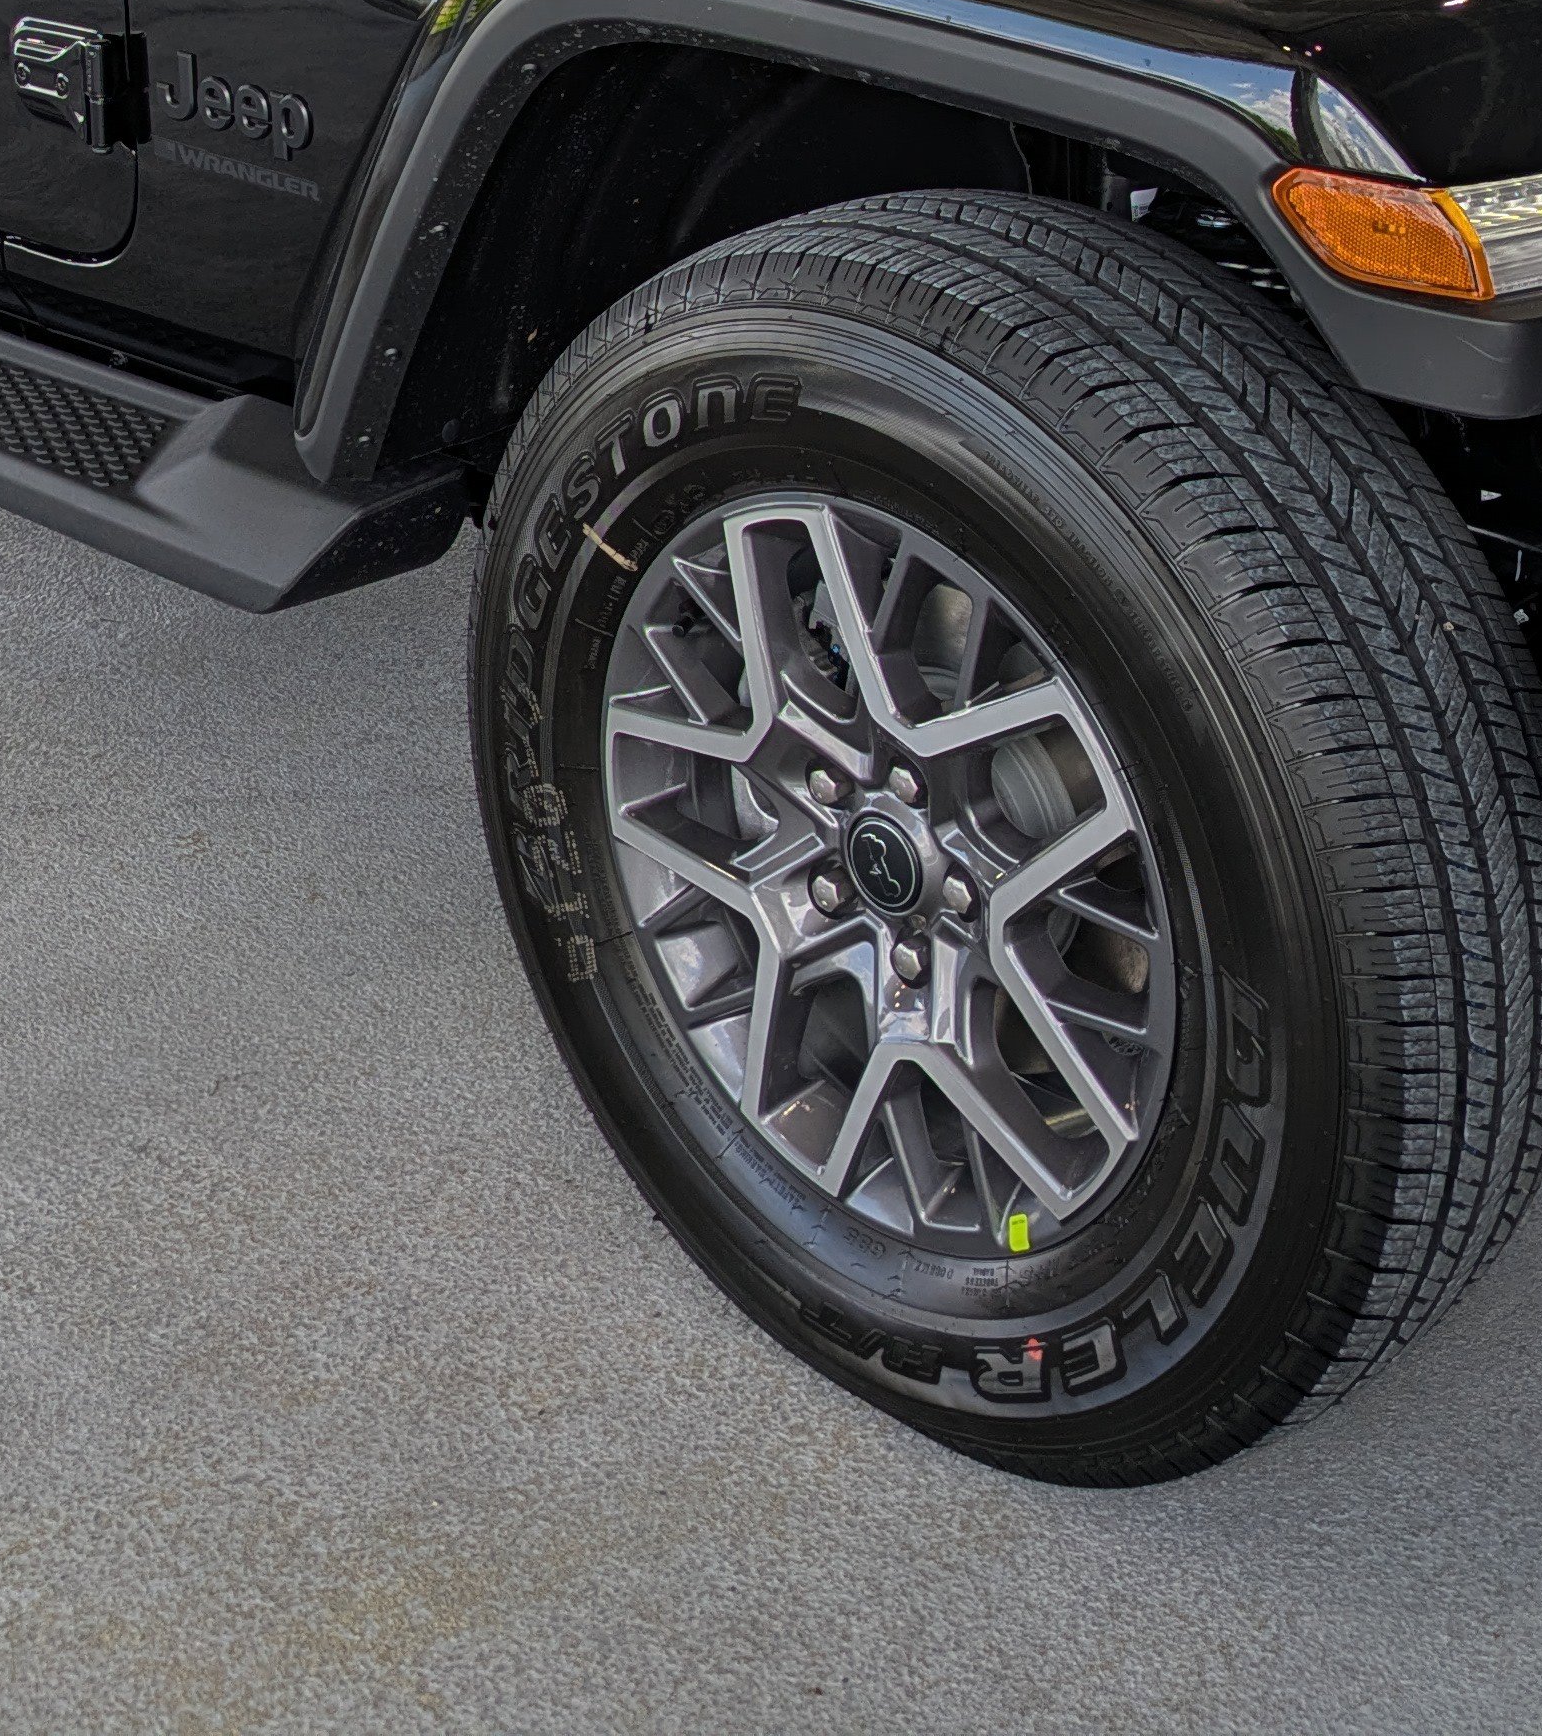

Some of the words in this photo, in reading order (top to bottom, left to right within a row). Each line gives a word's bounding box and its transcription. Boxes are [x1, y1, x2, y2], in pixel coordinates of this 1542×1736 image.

[156, 50, 314, 161] Jeep
[177, 143, 322, 202] WRANGLER
[504, 370, 803, 921] BRIDGESTONE
[972, 964, 1271, 1399] DUELER
